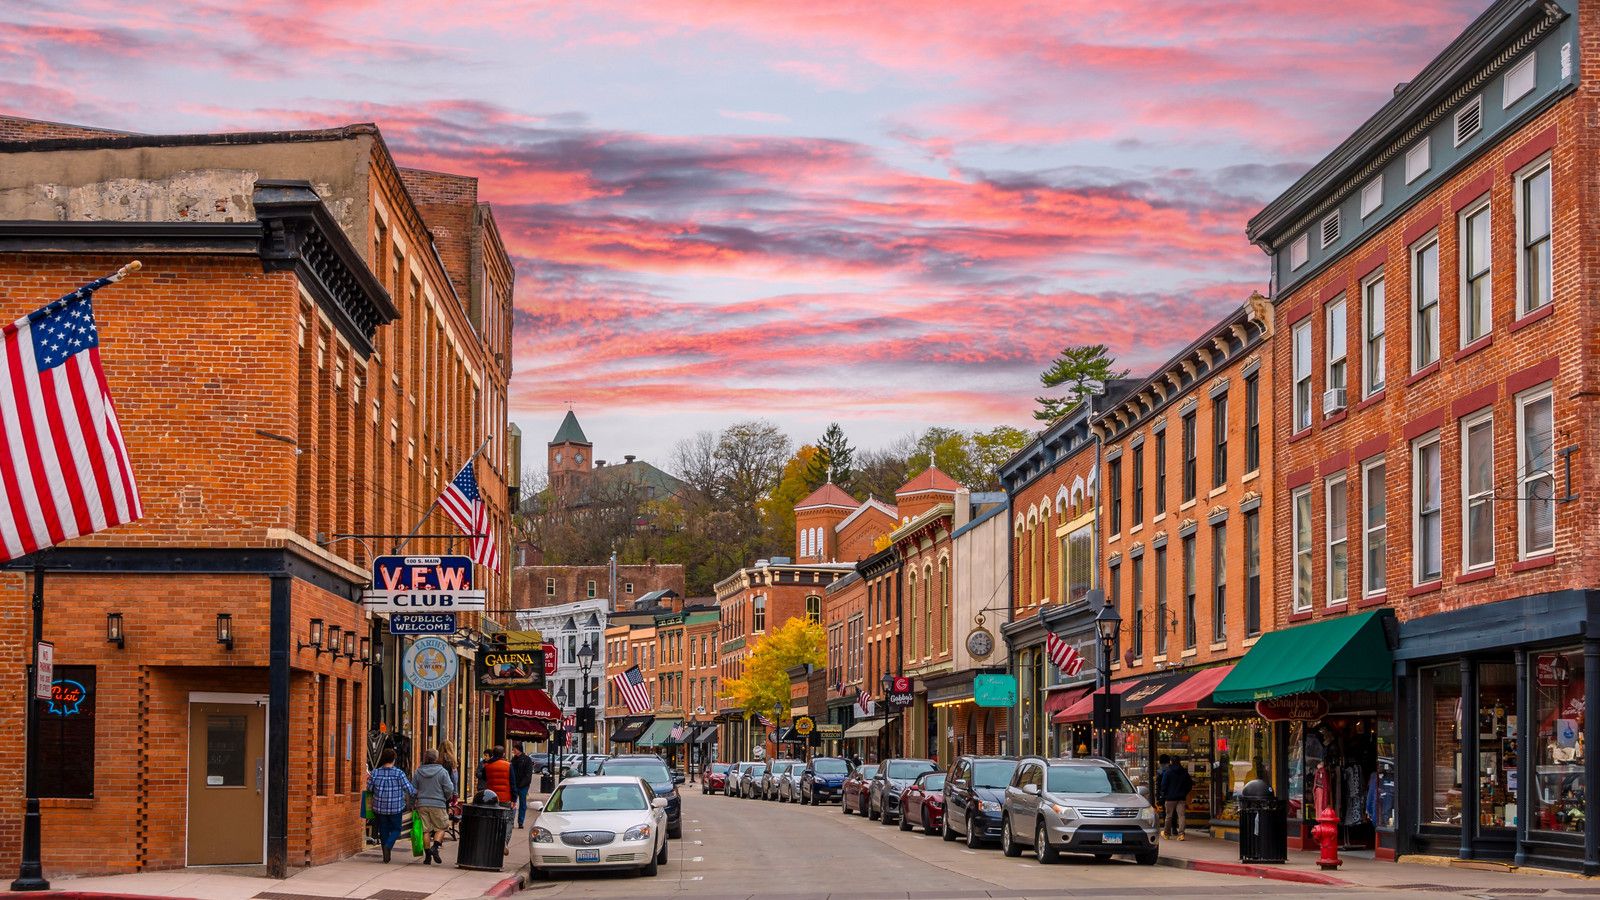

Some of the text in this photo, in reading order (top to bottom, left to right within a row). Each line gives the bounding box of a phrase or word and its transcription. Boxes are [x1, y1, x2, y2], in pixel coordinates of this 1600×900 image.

[393, 594, 453, 607] CLUB
[403, 615, 443, 623] PUBLIC
[395, 623, 450, 631] WELCOME
[485, 653, 534, 667] GALENA
[409, 672, 451, 689] TREASURES
[1268, 695, 1319, 713] Strawberry
